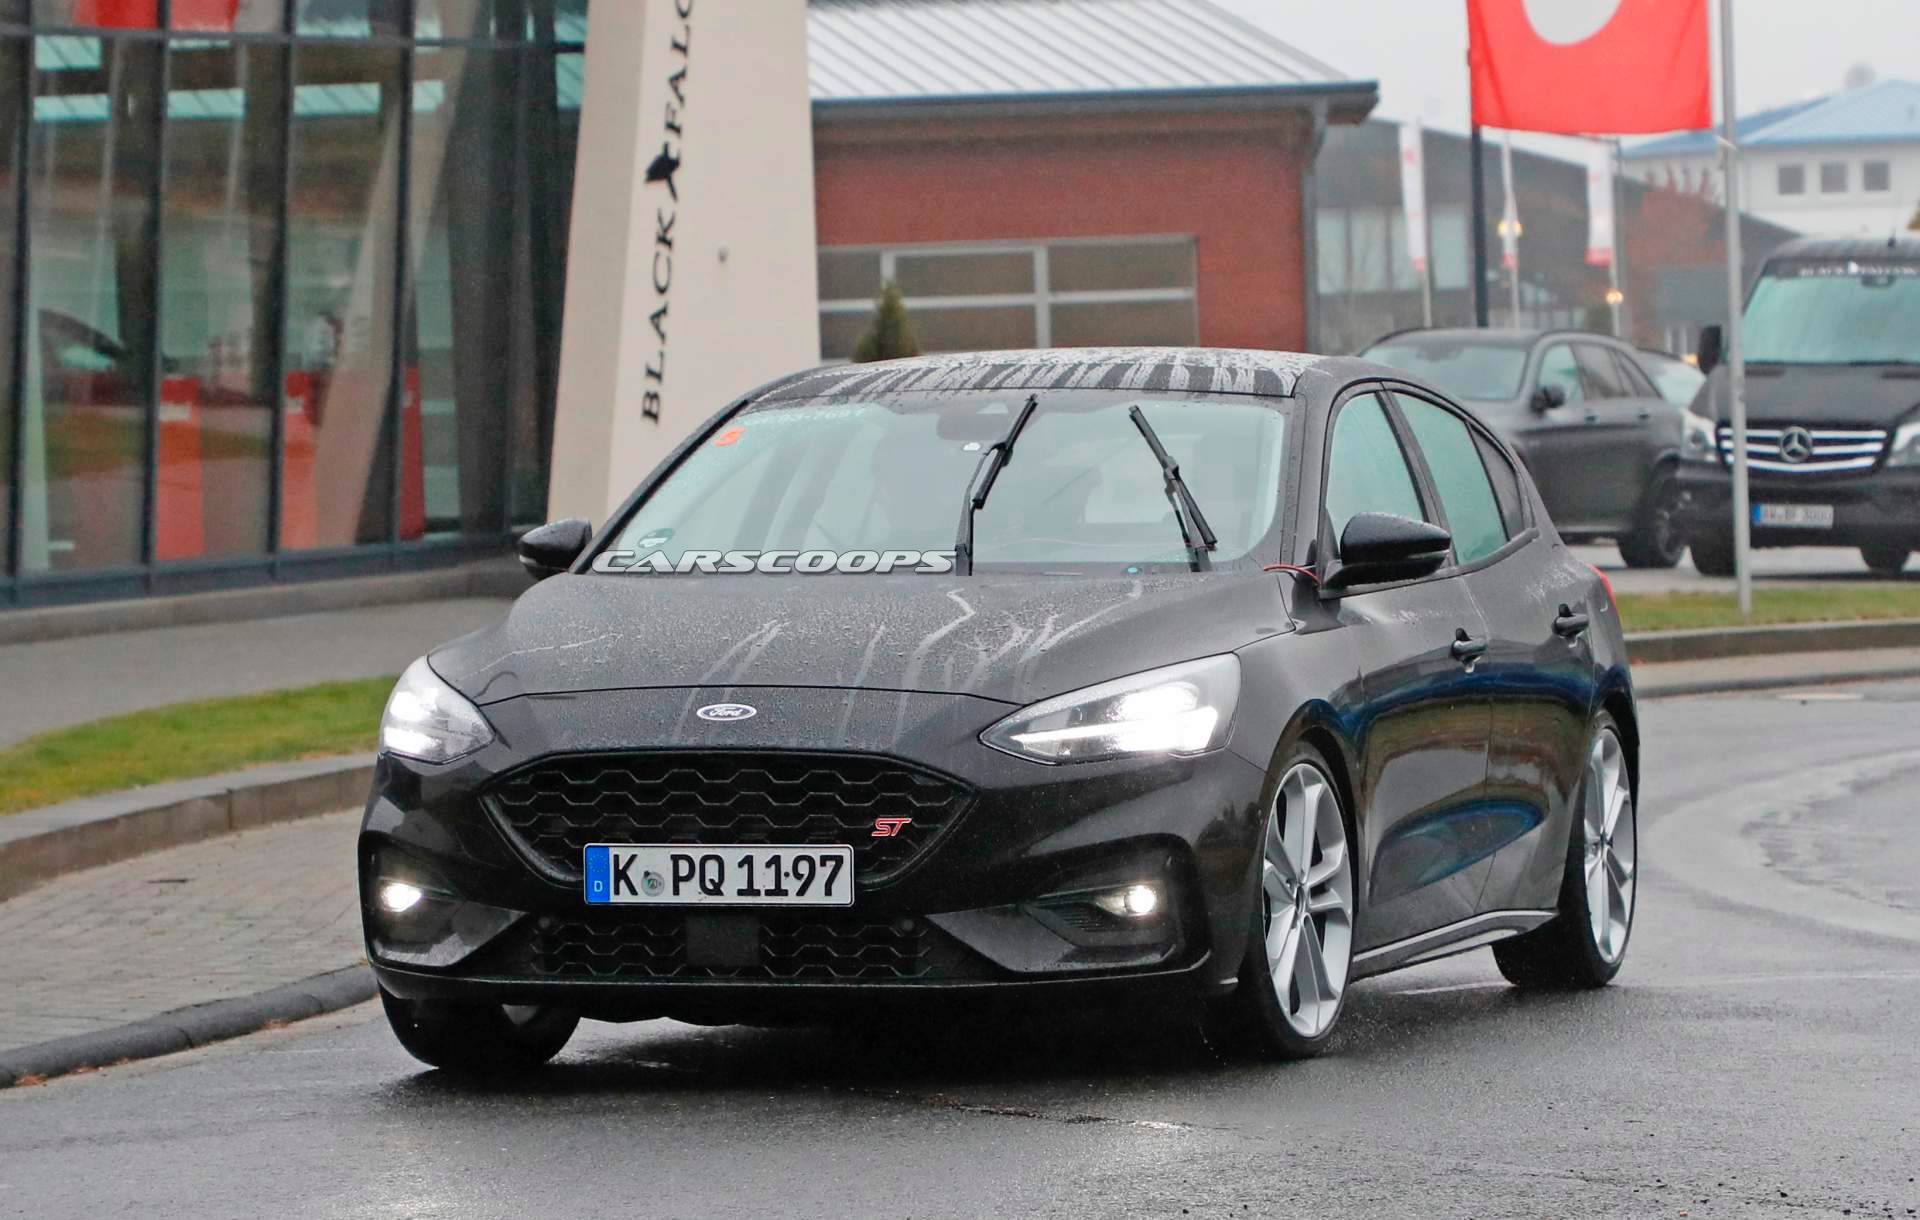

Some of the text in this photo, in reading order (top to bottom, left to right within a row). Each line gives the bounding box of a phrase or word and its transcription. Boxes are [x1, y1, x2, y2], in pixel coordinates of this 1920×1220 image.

[641, 208, 676, 426] BLACK
[709, 707, 744, 718] Ford
[871, 817, 912, 837] ST
[593, 854, 844, 897] D K PQ 1197
